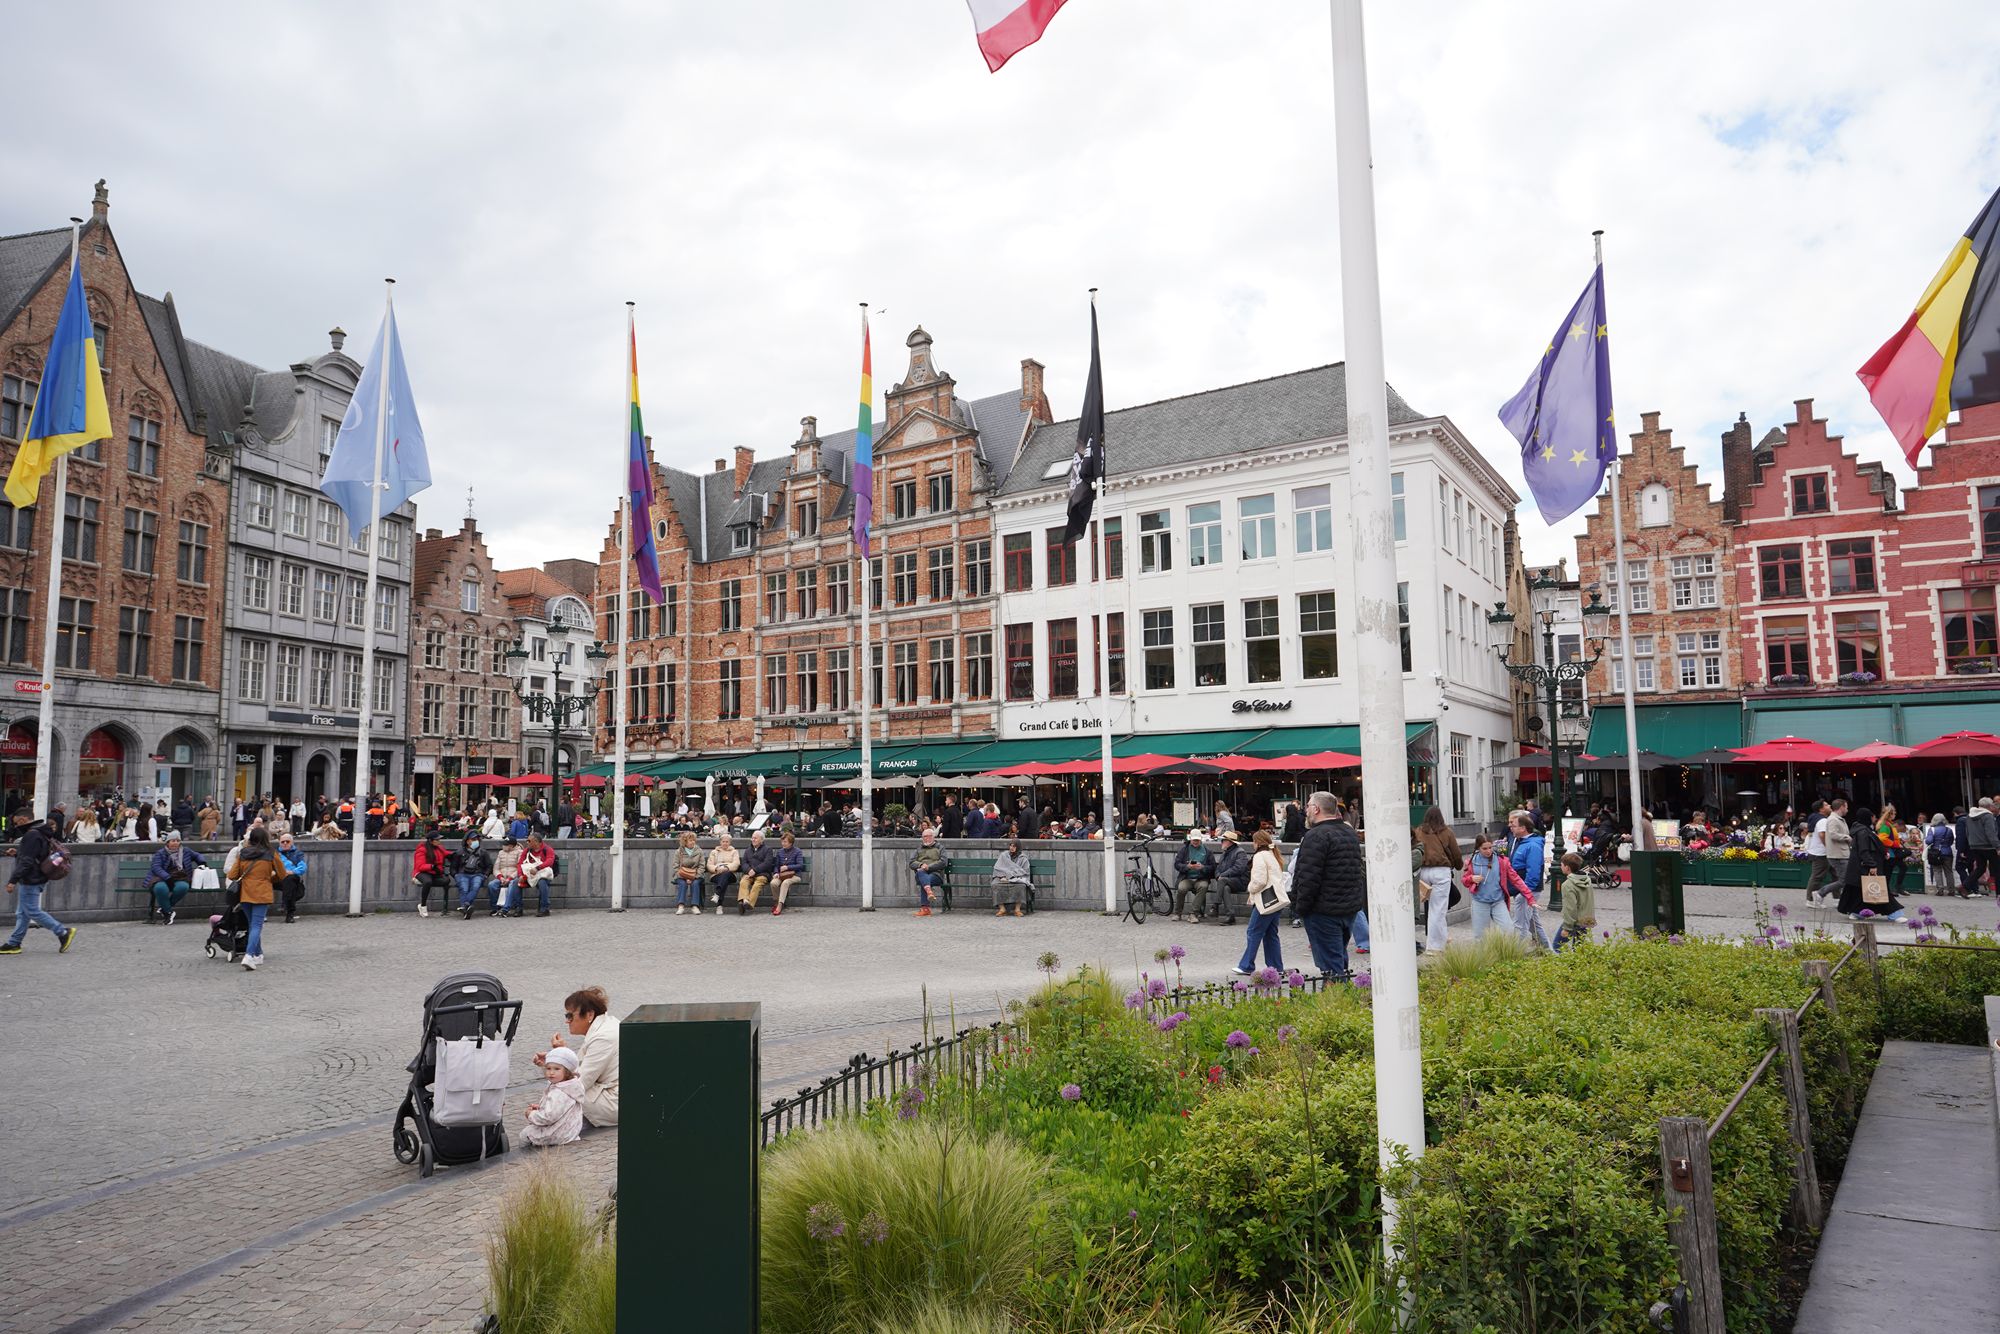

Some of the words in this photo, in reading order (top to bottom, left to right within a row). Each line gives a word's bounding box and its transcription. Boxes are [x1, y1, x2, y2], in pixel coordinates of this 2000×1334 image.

[24, 683, 42, 691] Kruid
[312, 714, 335, 726] fnac
[1020, 722, 1047, 732] Grand
[1049, 720, 1069, 730] Café
[1081, 718, 1112, 729] Belf
[0, 741, 31, 751] ruidvat
[235, 753, 256, 763] nac
[371, 758, 386, 766] nac
[792, 764, 811, 772] CFE
[822, 762, 862, 771] RESTAURAN
[879, 759, 917, 769] FRANÇAIS
[726, 769, 748, 777] MARIO
